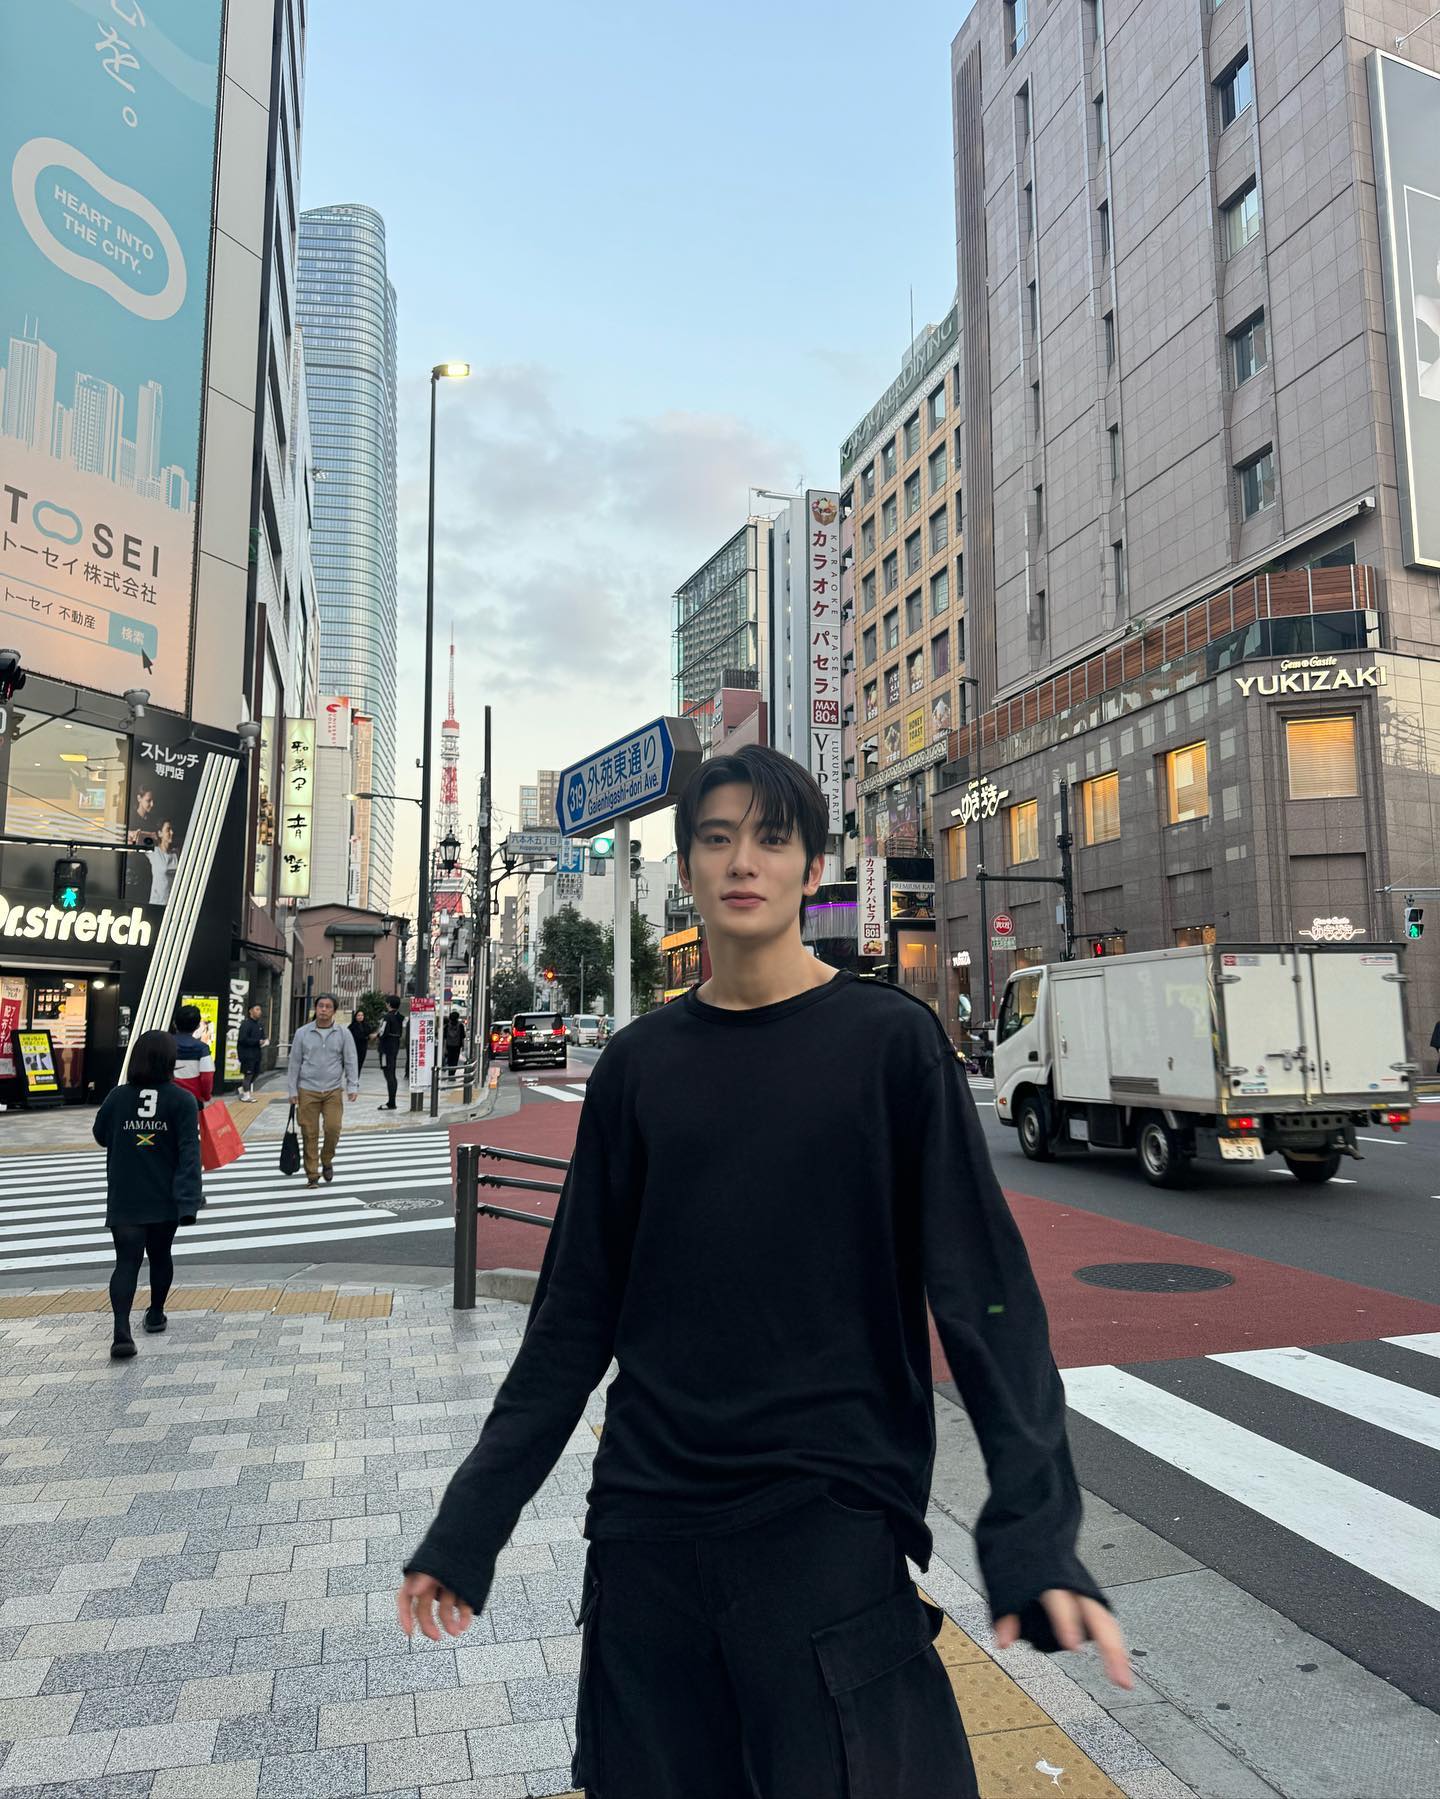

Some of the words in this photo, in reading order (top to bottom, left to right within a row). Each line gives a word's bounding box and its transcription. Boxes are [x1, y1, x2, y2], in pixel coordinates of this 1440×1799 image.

[54, 184, 112, 232] HEART
[116, 225, 154, 260] INTO
[62, 212, 98, 246] THE
[102, 239, 142, 275] CITY.
[3, 530, 157, 605] トーセイ株式会社
[812, 530, 829, 618] カラオケ
[830, 535, 838, 615] KARAOKE
[812, 630, 830, 694] パセラ
[831, 635, 839, 693] PASELA
[1280, 659, 1301, 672] Gem
[1309, 656, 1338, 668] Castle
[1234, 666, 1388, 697] YUKIZAKI
[815, 700, 836, 711] MAX
[815, 711, 838, 723] 80名
[140, 742, 199, 768] ストレッチ
[588, 734, 656, 796] 外苑東通り
[831, 740, 839, 783] LUXURY
[155, 763, 185, 781] 専門店
[644, 774, 659, 791] Ave.
[569, 782, 584, 813] 319
[832, 788, 840, 822] PARTY
[511, 834, 557, 846] 六本木五丁目
[865, 857, 877, 922] カラオケパセラ
[137, 1089, 158, 1118] 3
[123, 1120, 168, 1131] JAMAICA
